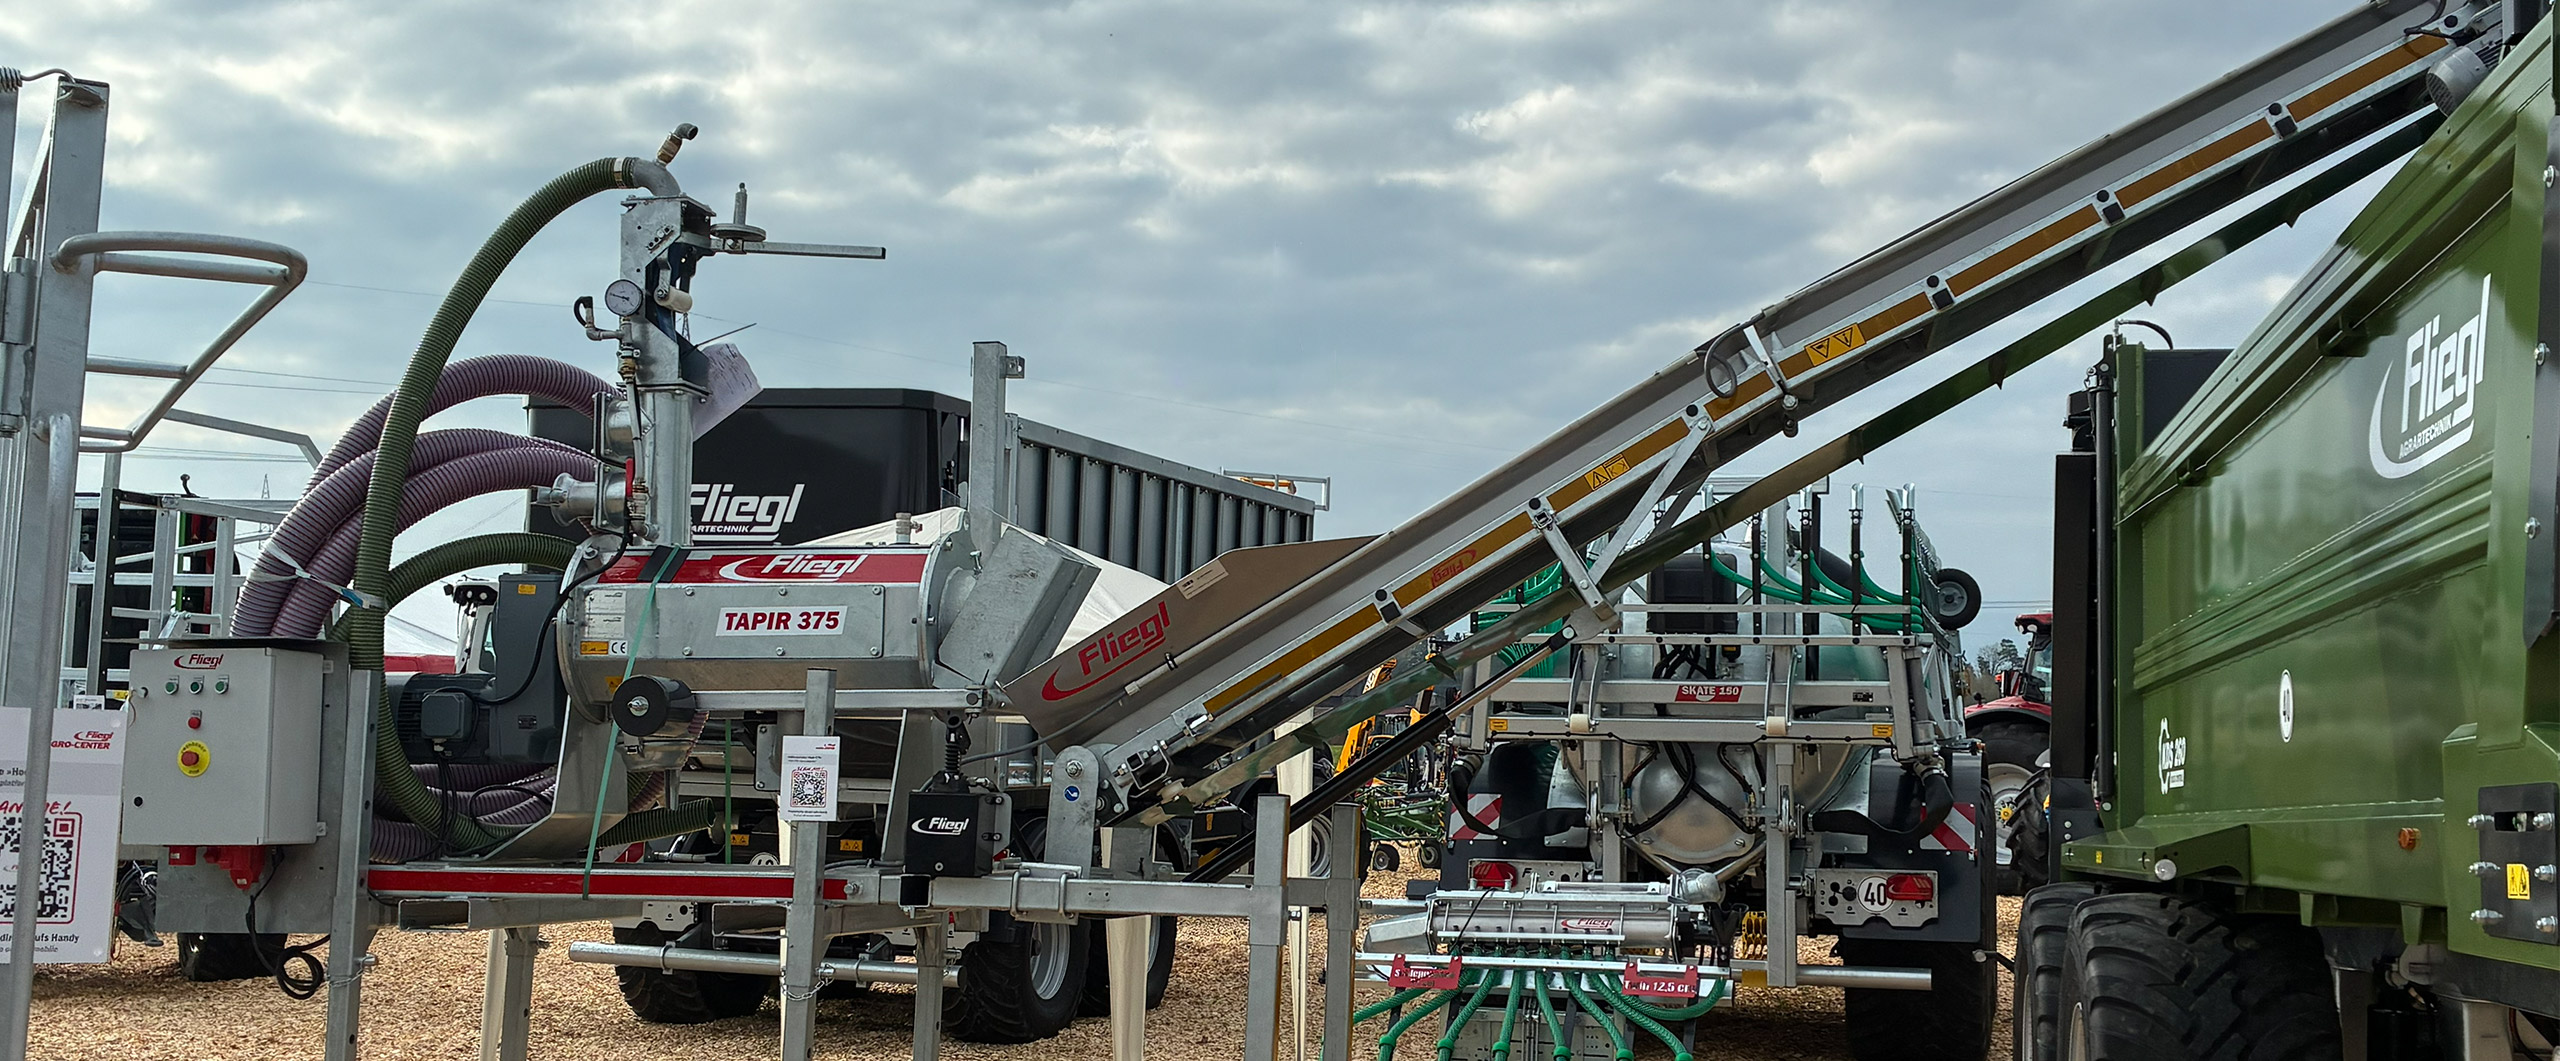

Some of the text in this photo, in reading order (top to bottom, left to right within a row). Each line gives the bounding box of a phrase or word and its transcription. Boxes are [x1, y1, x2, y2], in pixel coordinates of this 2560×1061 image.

[2401, 273, 2491, 433] Fliegl
[2399, 412, 2452, 460] AGRARTECHNIK
[691, 484, 805, 532] Fliegl
[691, 525, 750, 533] ARTECHNIK
[760, 554, 868, 578] Fliegl
[725, 611, 840, 631] TAPIR 375
[1078, 601, 1171, 676] Fliegl
[188, 653, 224, 670] Fliegl
[1681, 685, 1739, 696] SKATE 150
[50, 740, 111, 749] GRO-CENTER
[85, 730, 114, 742] Fliegl
[928, 817, 970, 834] Fliegl
[1864, 882, 1888, 906] 40
[51, 933, 79, 944] Handy
